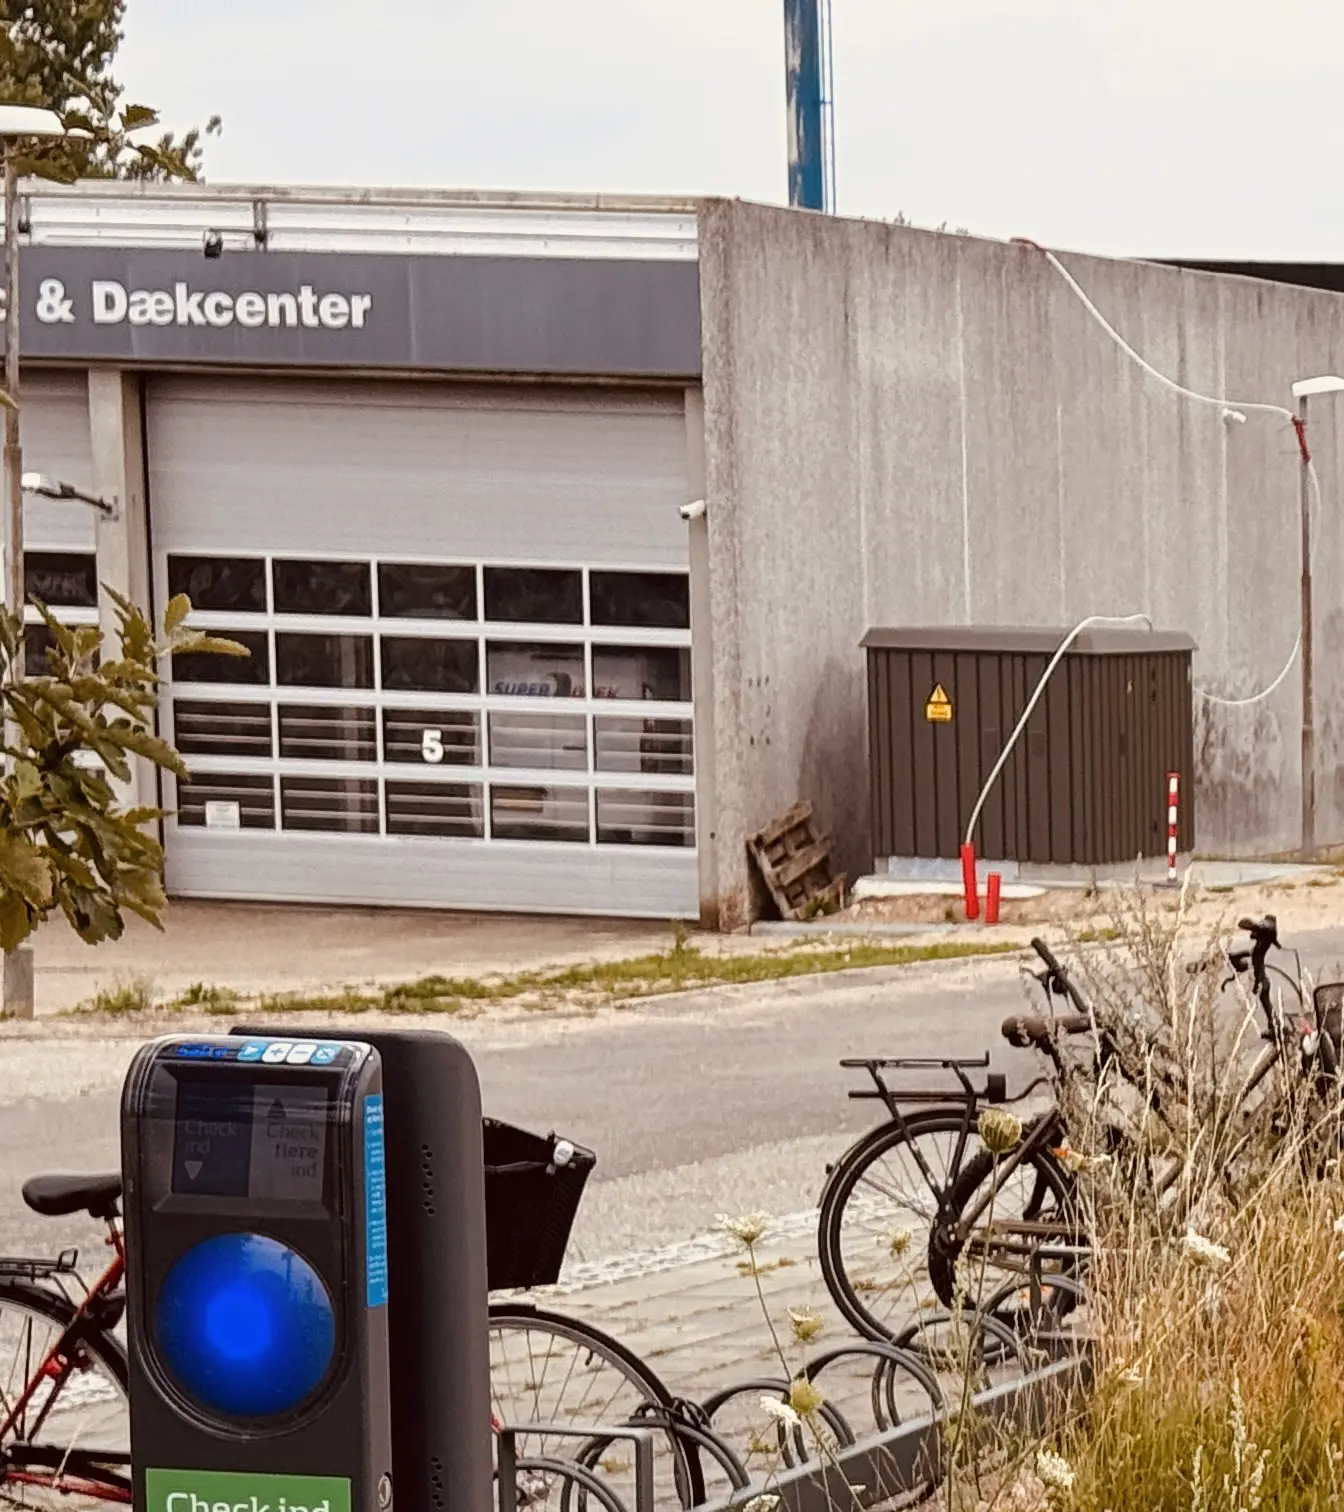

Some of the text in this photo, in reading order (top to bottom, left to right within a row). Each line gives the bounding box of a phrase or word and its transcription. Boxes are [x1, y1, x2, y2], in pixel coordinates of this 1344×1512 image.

[36, 278, 76, 324] &
[92, 280, 372, 328] Dækcenter
[422, 729, 444, 763] 5
[184, 1119, 237, 1137] Check
[266, 1122, 318, 1140] Check
